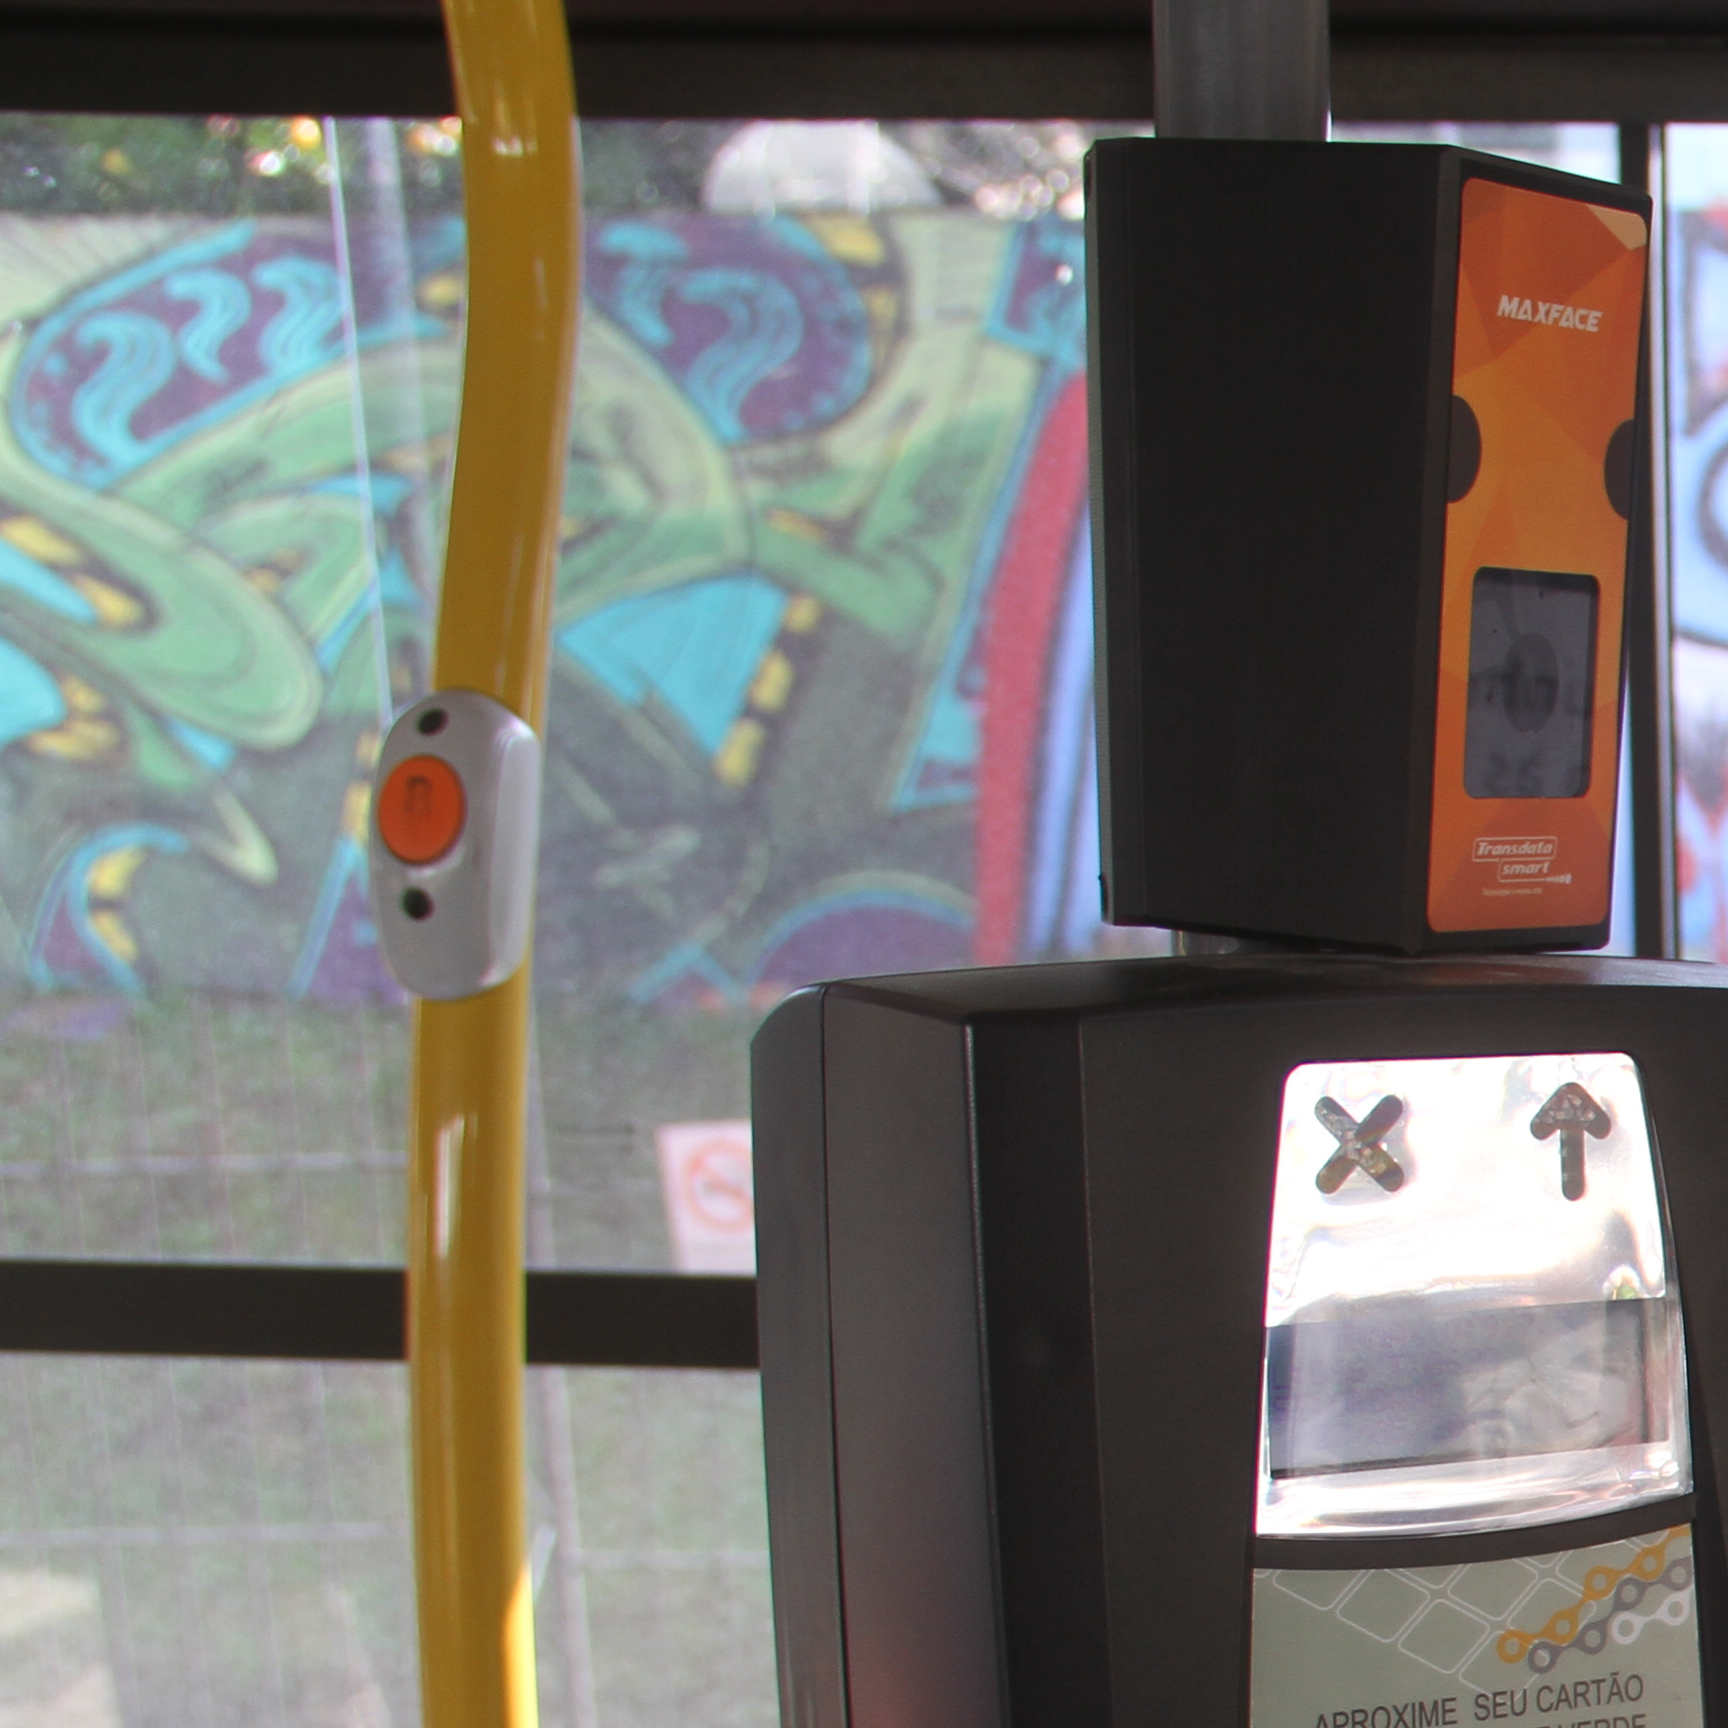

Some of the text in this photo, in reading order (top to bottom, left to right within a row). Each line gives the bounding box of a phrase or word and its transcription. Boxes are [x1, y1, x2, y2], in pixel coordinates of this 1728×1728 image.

[1497, 294, 1604, 332] MAXFACE
[1476, 841, 1554, 856] Transdata
[1501, 861, 1551, 875] smart
[1473, 1687, 1528, 1722] SEU
[1535, 1671, 1645, 1714] CARTÃO
